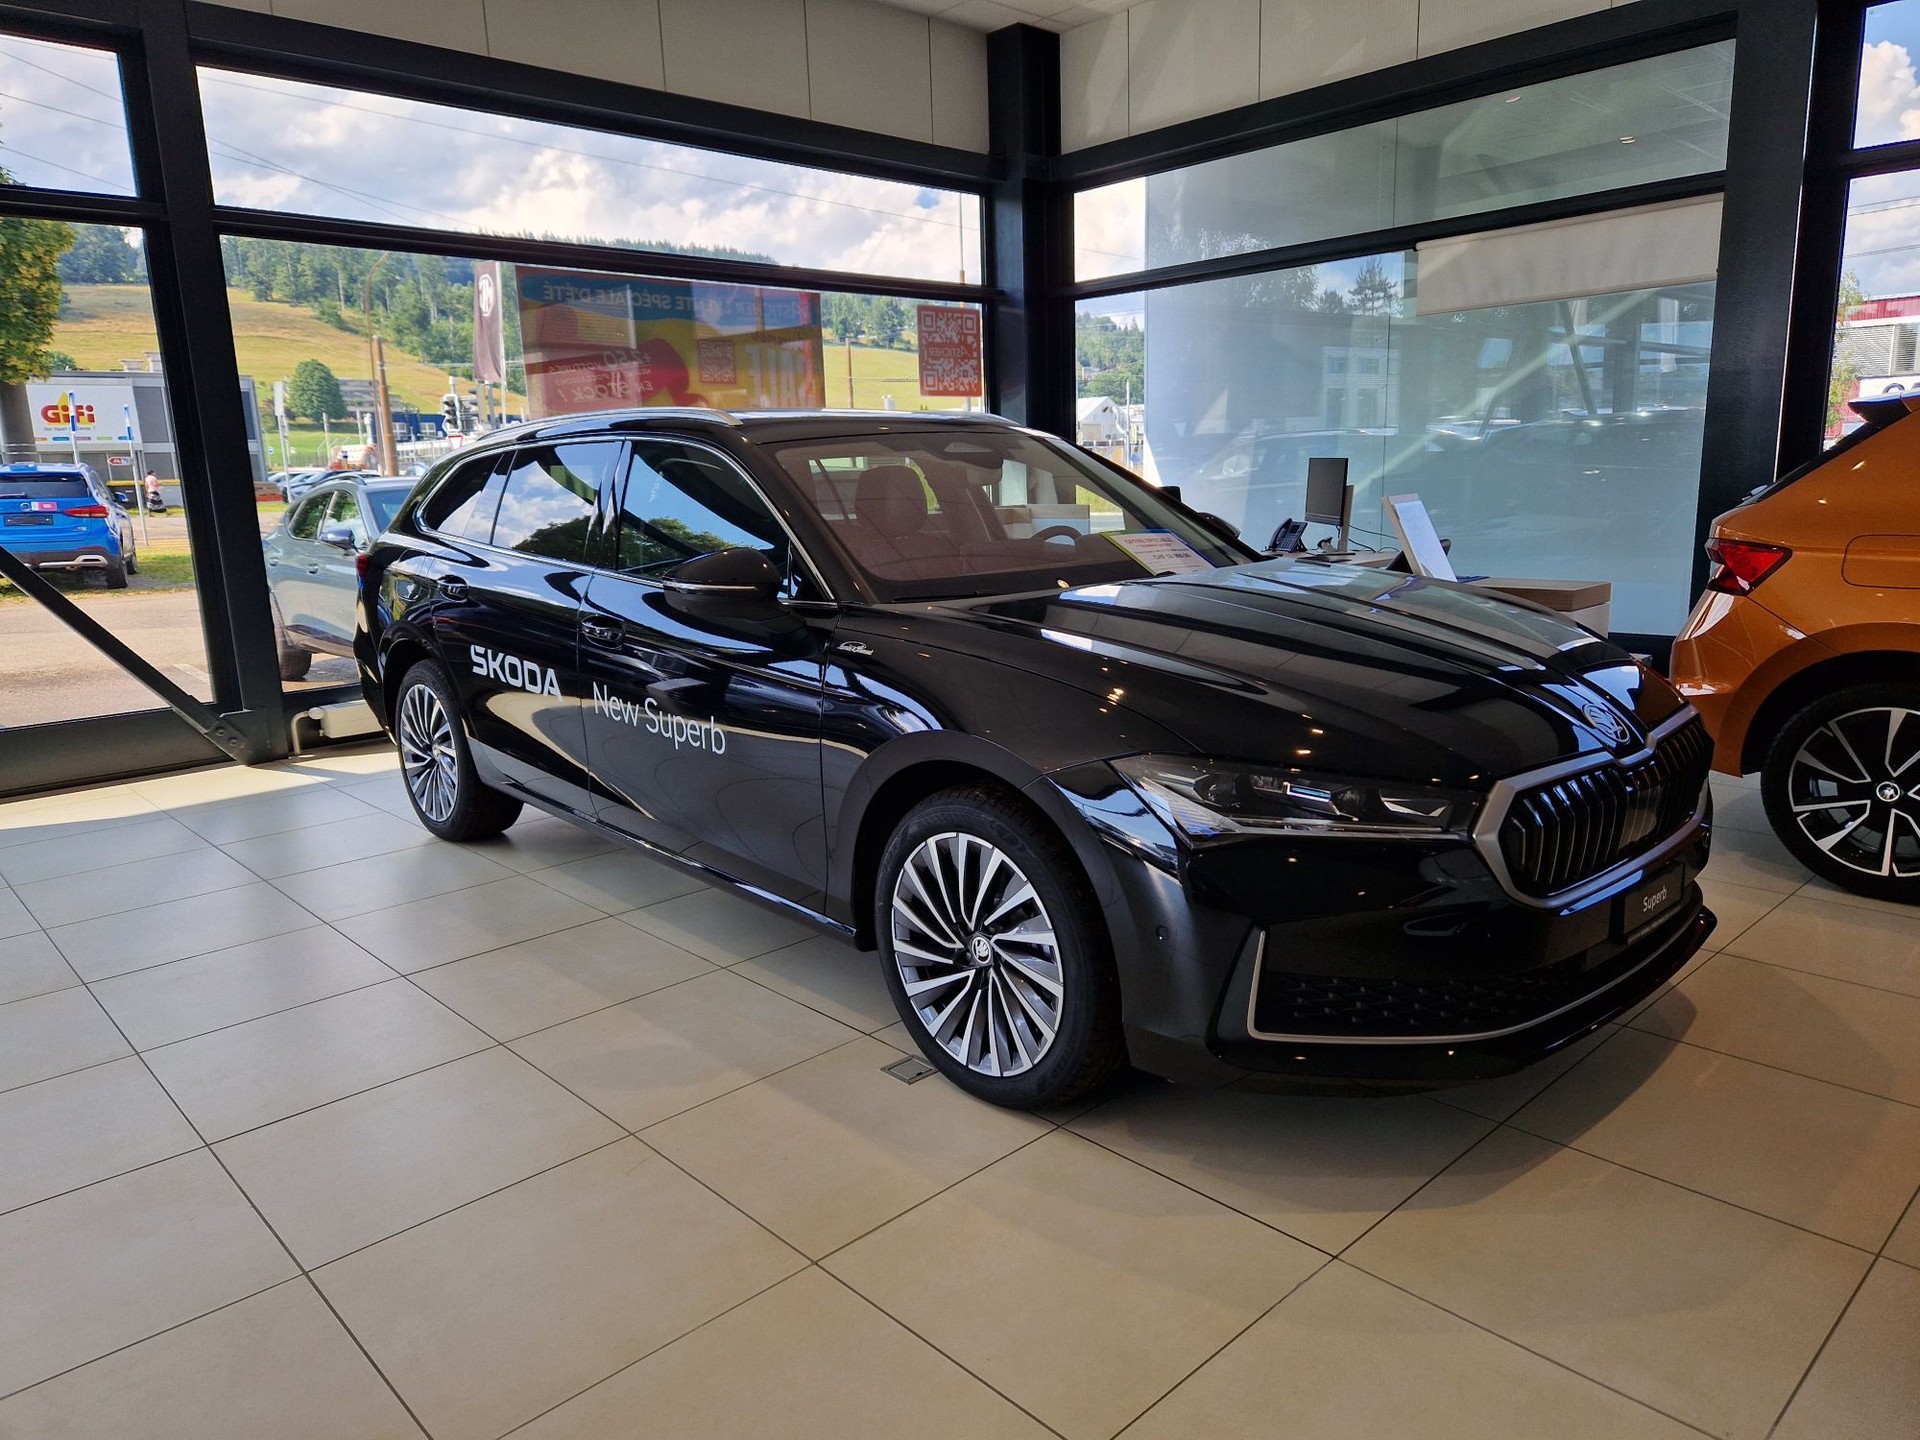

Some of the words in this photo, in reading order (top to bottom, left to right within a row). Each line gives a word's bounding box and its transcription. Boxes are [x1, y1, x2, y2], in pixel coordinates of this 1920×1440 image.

[592, 681, 640, 727] New
[644, 697, 726, 755] Superb
[1642, 884, 1667, 912] Superb
